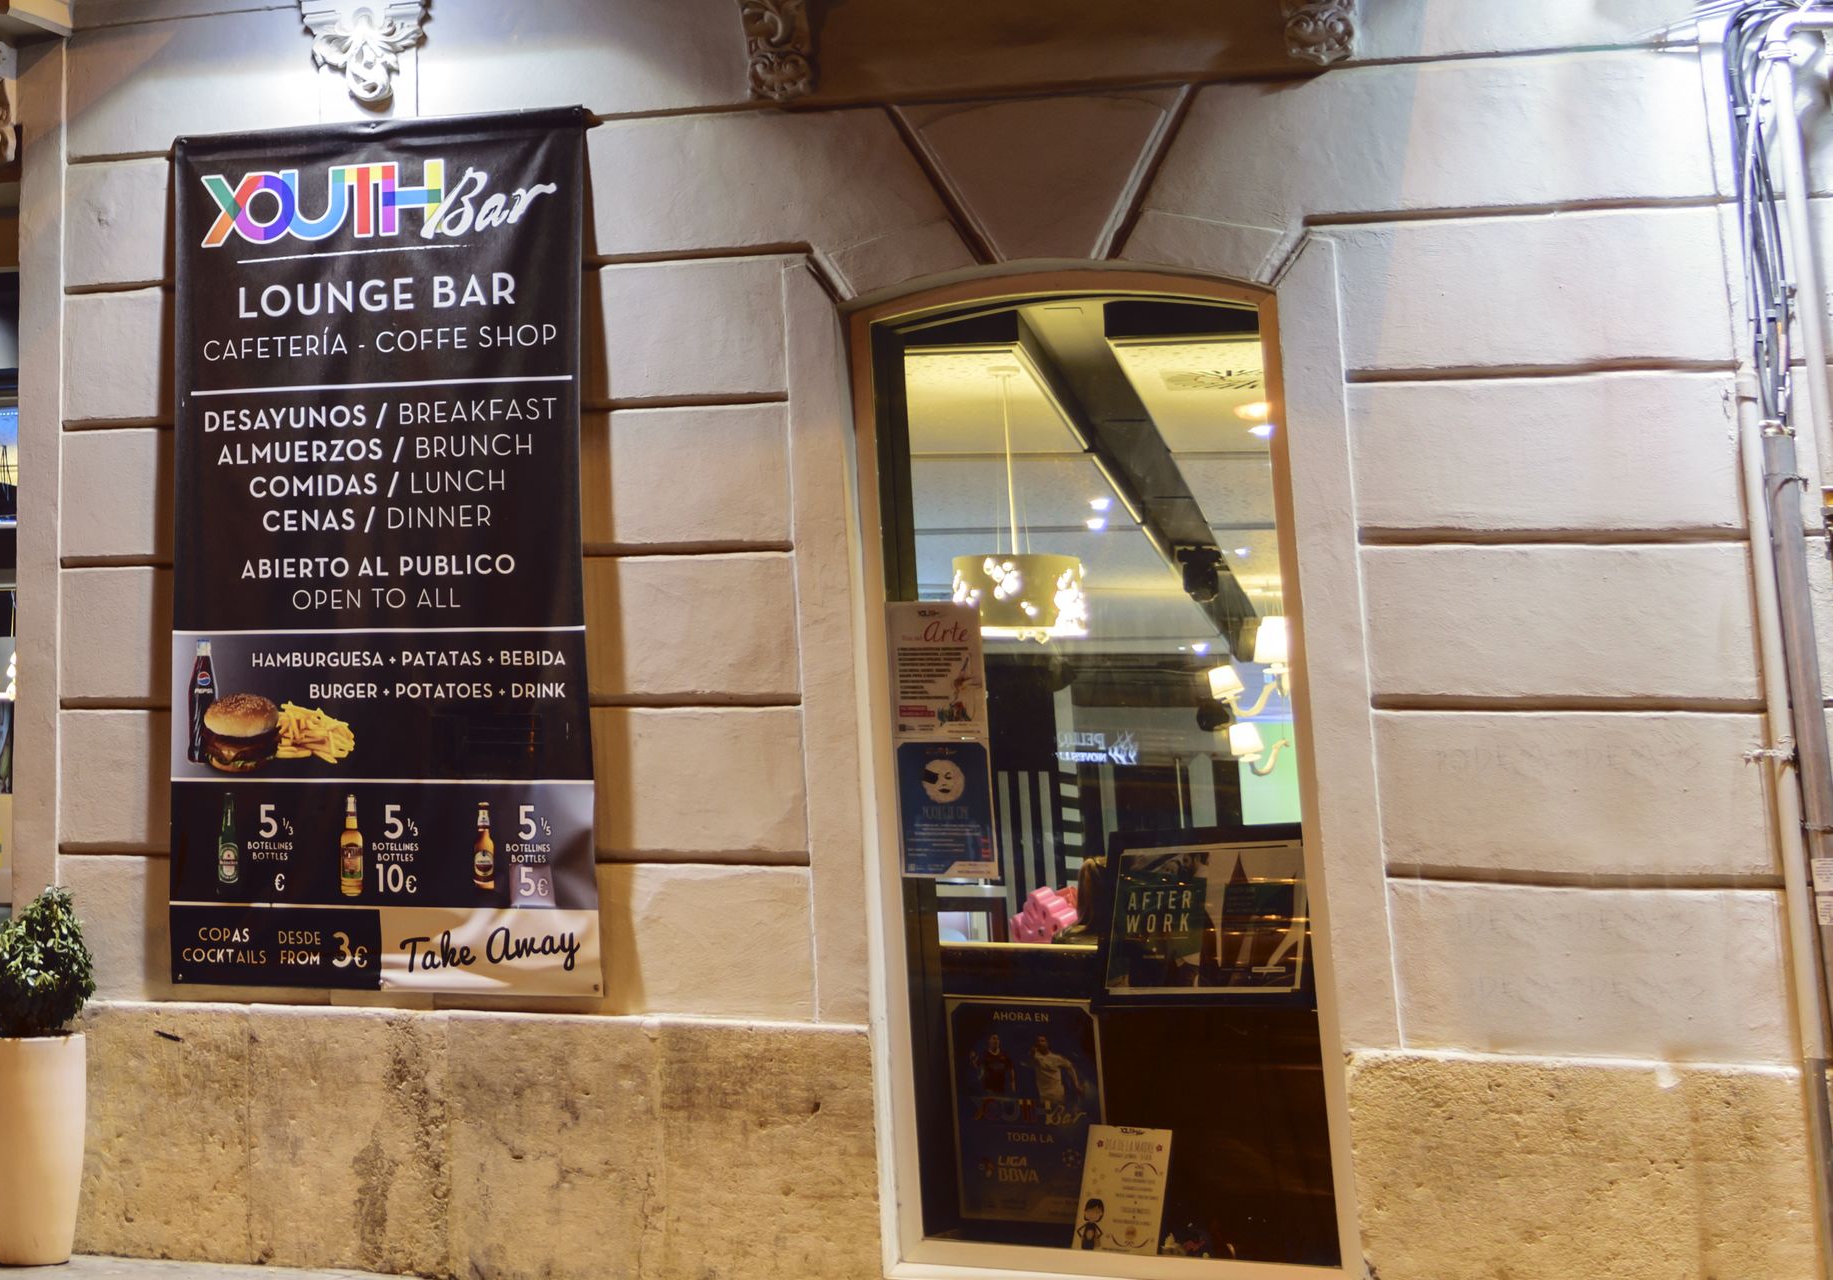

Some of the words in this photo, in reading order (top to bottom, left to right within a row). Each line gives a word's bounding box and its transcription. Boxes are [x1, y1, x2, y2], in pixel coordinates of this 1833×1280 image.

[201, 159, 444, 248] YOUTH
[420, 167, 557, 239] Bar
[238, 277, 414, 319] LOUNGE
[433, 272, 516, 309] BAR
[203, 327, 348, 362] CAFETERÍA
[375, 327, 468, 354] COFFE
[478, 324, 557, 348] SHOP
[204, 404, 367, 433] DESAYUNOS
[399, 397, 557, 425] BREAKFAST
[217, 439, 382, 466] ALMUERZOS
[415, 433, 533, 460] BRUNCH
[249, 474, 377, 498] COMIDAS
[410, 469, 506, 495] LUNCH
[262, 508, 355, 532] CENAS
[387, 504, 491, 530] DINNER
[241, 557, 349, 580] ABIERTO
[358, 556, 389, 576] AL
[399, 554, 516, 576] PUBLICO
[292, 588, 362, 611] OPEN
[372, 587, 406, 609] TO
[416, 586, 460, 608] ALL
[252, 651, 384, 668] HAMBURGUESA
[402, 651, 481, 667] PATATAS
[500, 650, 566, 667] BEBIDA
[309, 683, 377, 699] BURGER
[396, 683, 493, 699] POTATOES
[511, 682, 566, 699] DRINK
[259, 804, 278, 838] 5
[383, 804, 404, 839] 5
[518, 804, 537, 840] 5
[247, 841, 293, 851] BOTELLINES
[252, 852, 288, 861] BOTTLES
[372, 842, 419, 851] BOTELLINES
[505, 843, 551, 853] BOTELLINES
[377, 853, 414, 862] BOTTLES
[511, 854, 546, 864] BOTTLES
[375, 863, 417, 894] 10€
[1127, 890, 1193, 911] AFTER
[1125, 912, 1190, 934] WORK
[198, 927, 249, 942] COPAS
[278, 930, 321, 945] DESDE
[182, 947, 267, 964] COCKTAILS
[280, 950, 320, 966] FROM
[400, 930, 476, 973] Take
[485, 926, 580, 971] Away
[992, 1010, 1032, 1022] AHORA
[1035, 1012, 1050, 1023] EN
[1006, 1131, 1037, 1143] TODA
[1040, 1133, 1054, 1144] LA
[997, 1154, 1028, 1167] LIGA
[998, 1168, 1039, 1184] BBVA
